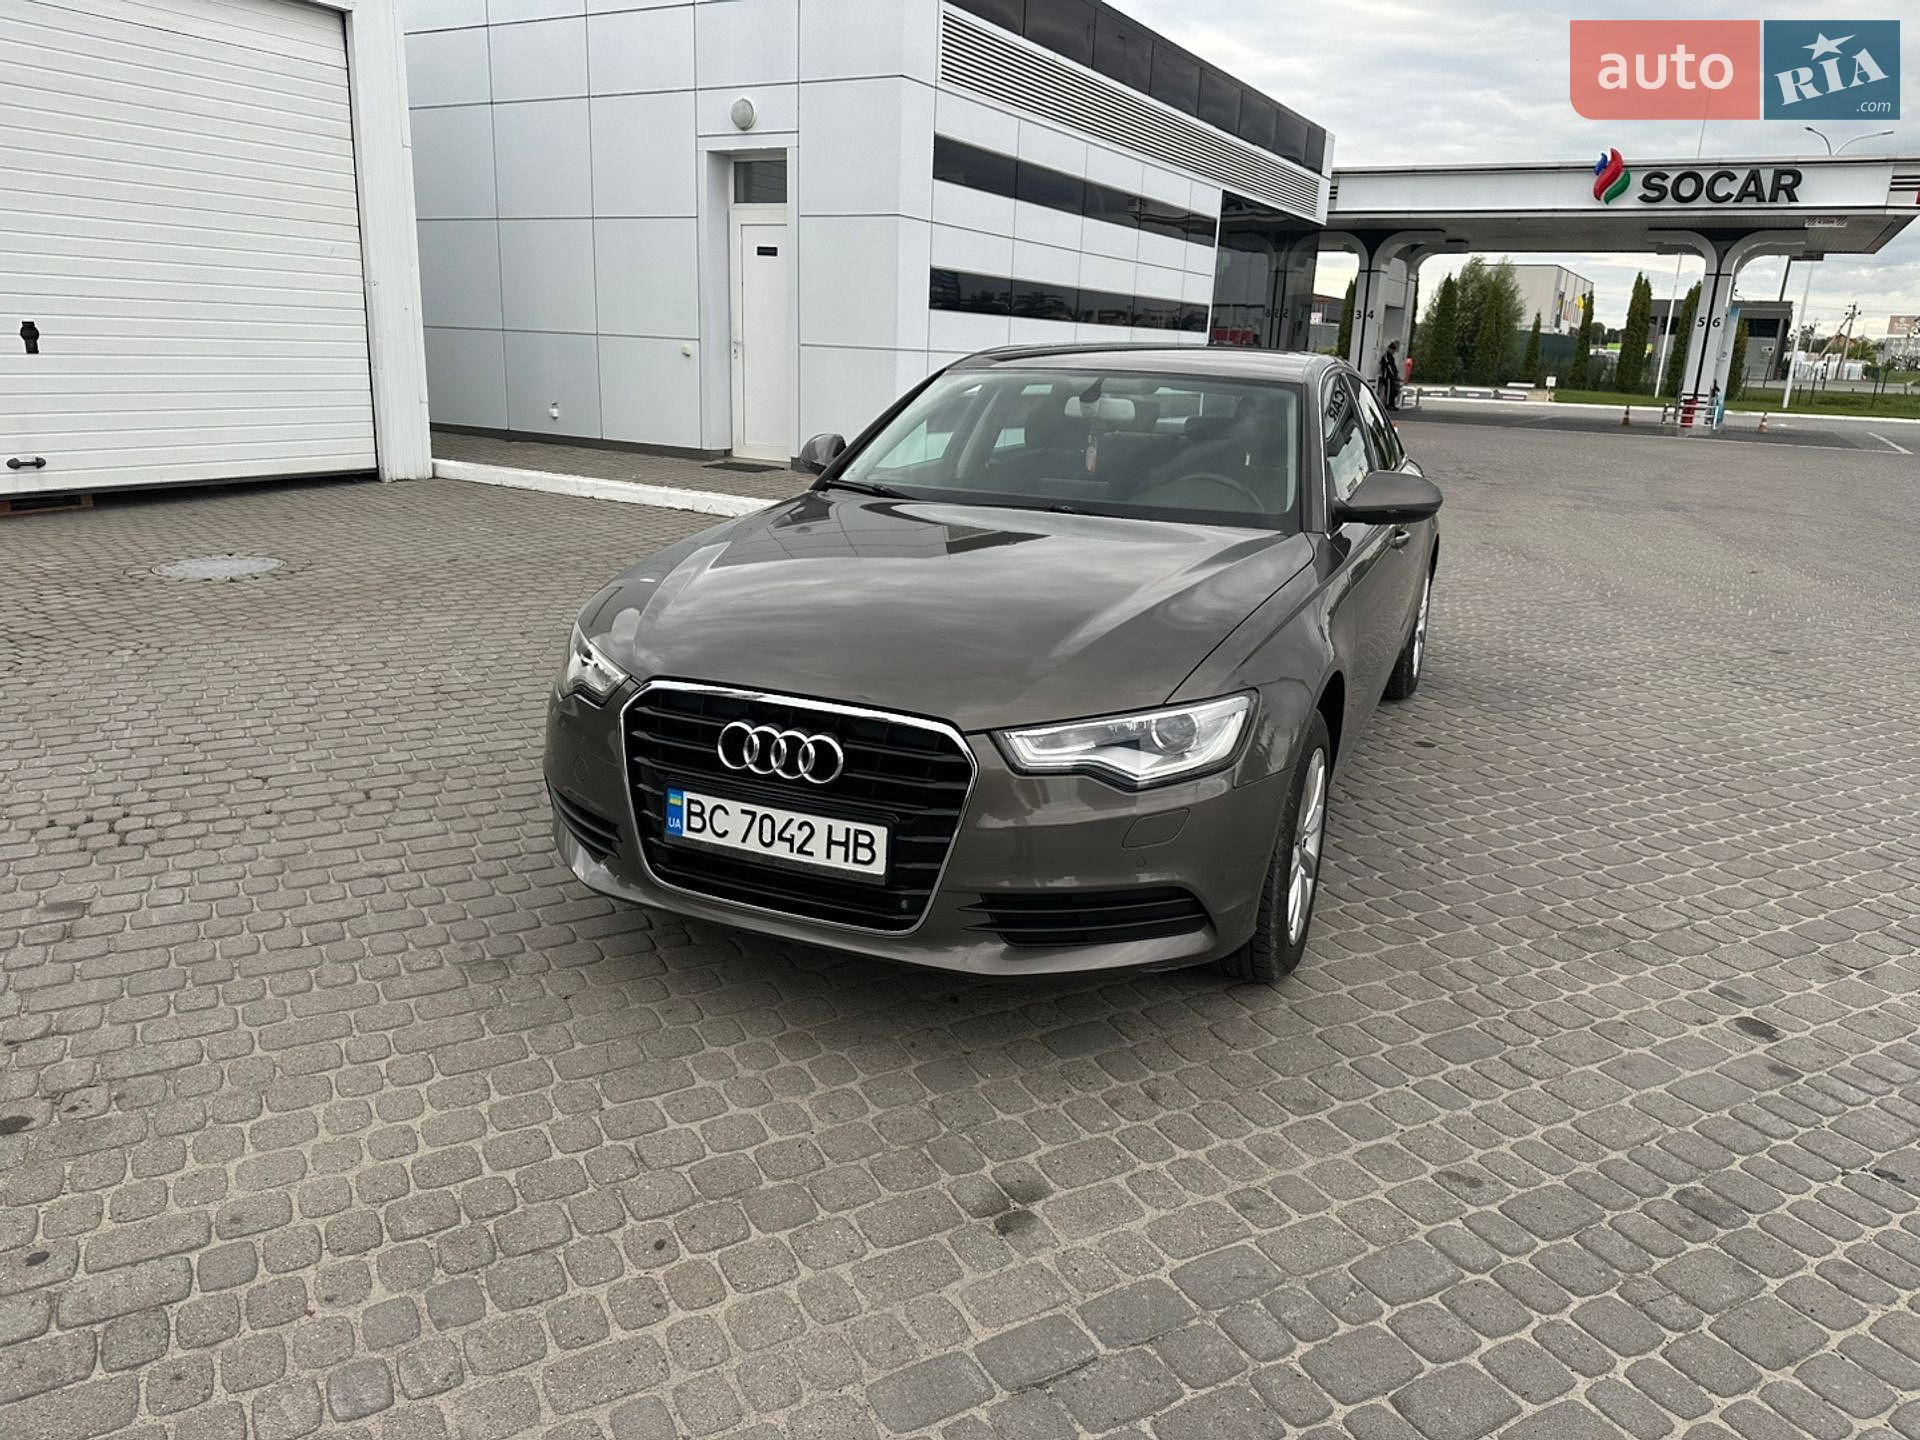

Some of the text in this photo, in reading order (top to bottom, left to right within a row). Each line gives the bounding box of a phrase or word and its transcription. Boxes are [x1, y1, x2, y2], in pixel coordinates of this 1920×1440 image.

[1637, 168, 1803, 204] SOCAR
[1355, 310, 1362, 320] 3
[1367, 310, 1374, 320] 4
[1696, 316, 1706, 328] 5
[1712, 316, 1721, 328] 6
[668, 817, 681, 829] UA
[686, 798, 877, 865] BC 7042 HB
